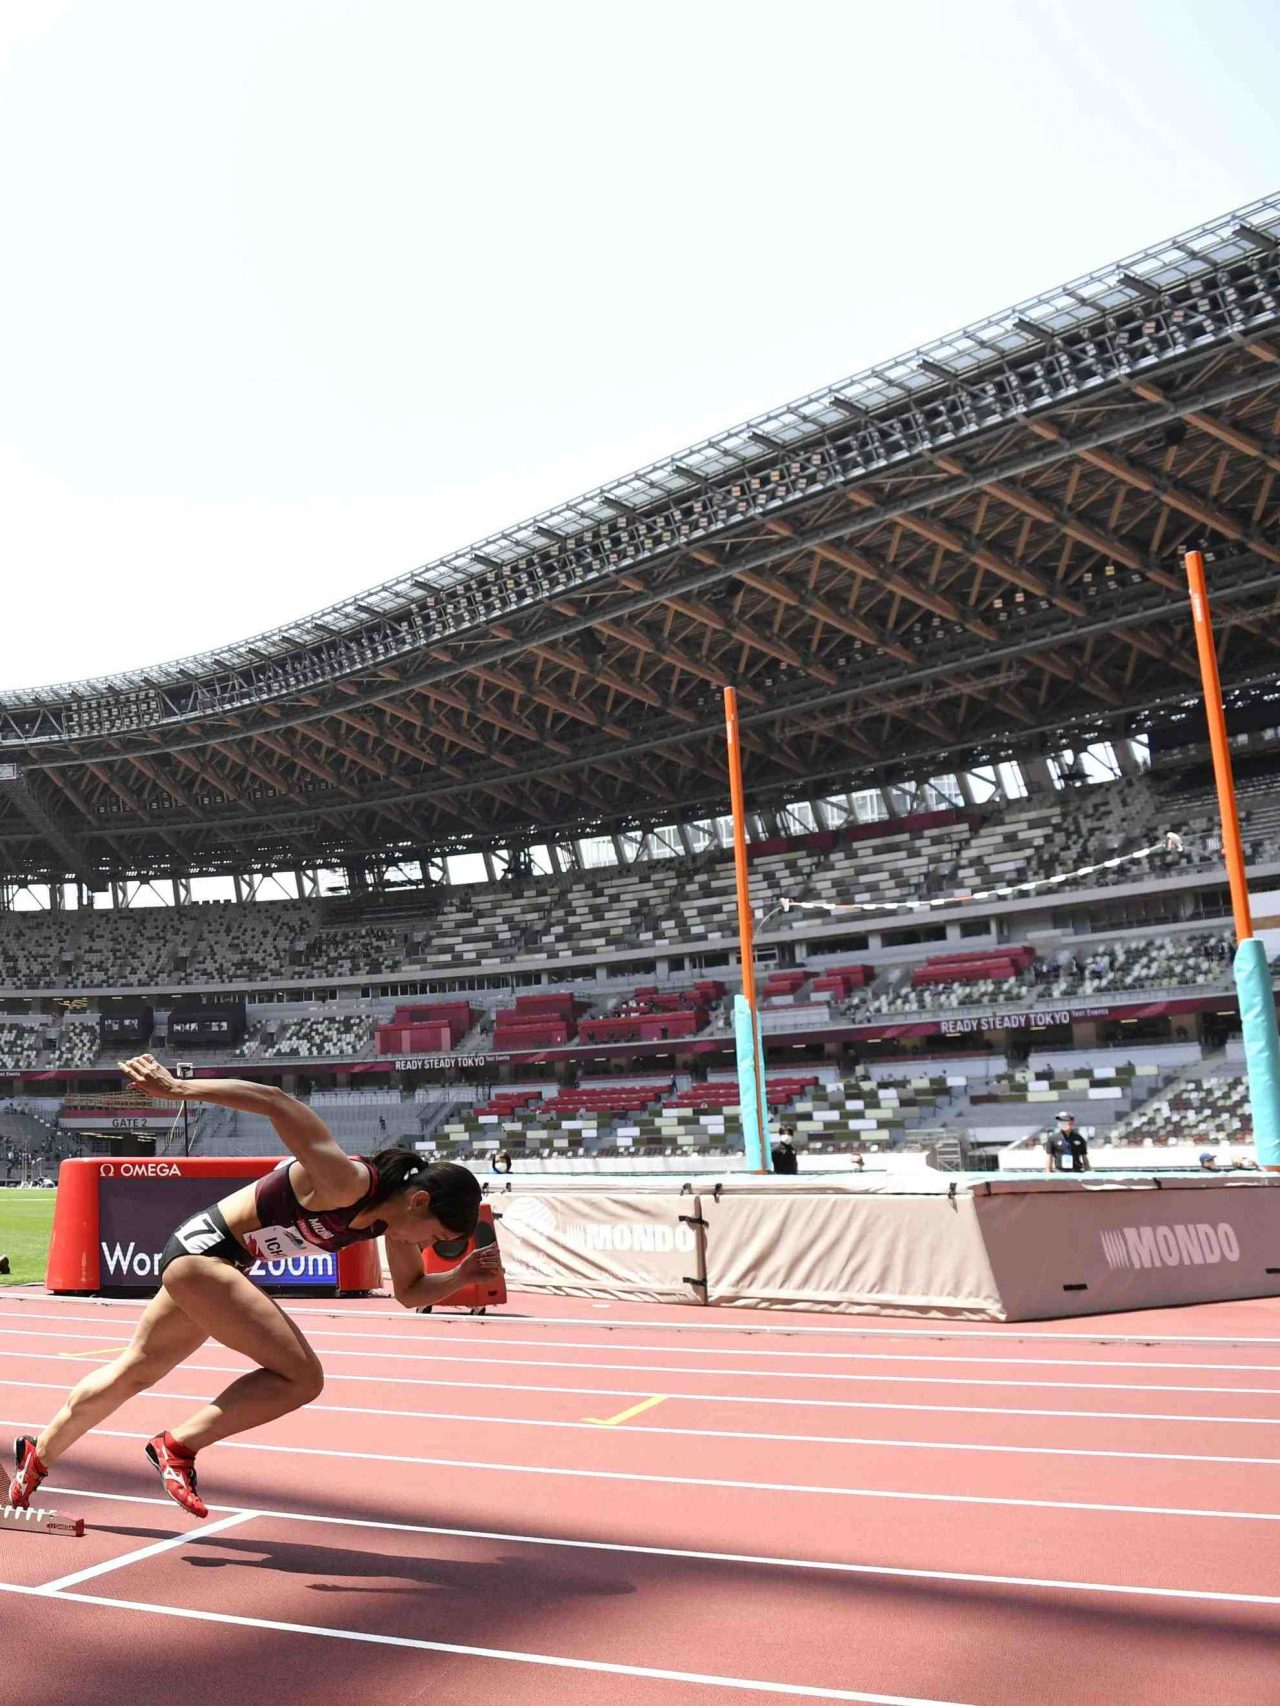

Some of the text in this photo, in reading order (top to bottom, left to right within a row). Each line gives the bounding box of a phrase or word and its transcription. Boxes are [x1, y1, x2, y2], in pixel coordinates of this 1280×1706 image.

[940, 1020, 979, 1033] READY
[980, 1014, 1027, 1031] STEADY
[1028, 1011, 1070, 1027] TOKYO
[395, 1060, 423, 1070] READY
[424, 1058, 458, 1070] STEADY
[457, 1057, 485, 1067] TOKYO
[112, 1119, 148, 1128] GATE 2
[120, 1163, 182, 1177] OMEGA
[183, 1218, 217, 1243] 7
[587, 1223, 697, 1254] MONDO
[1122, 1222, 1241, 1269] MONDO
